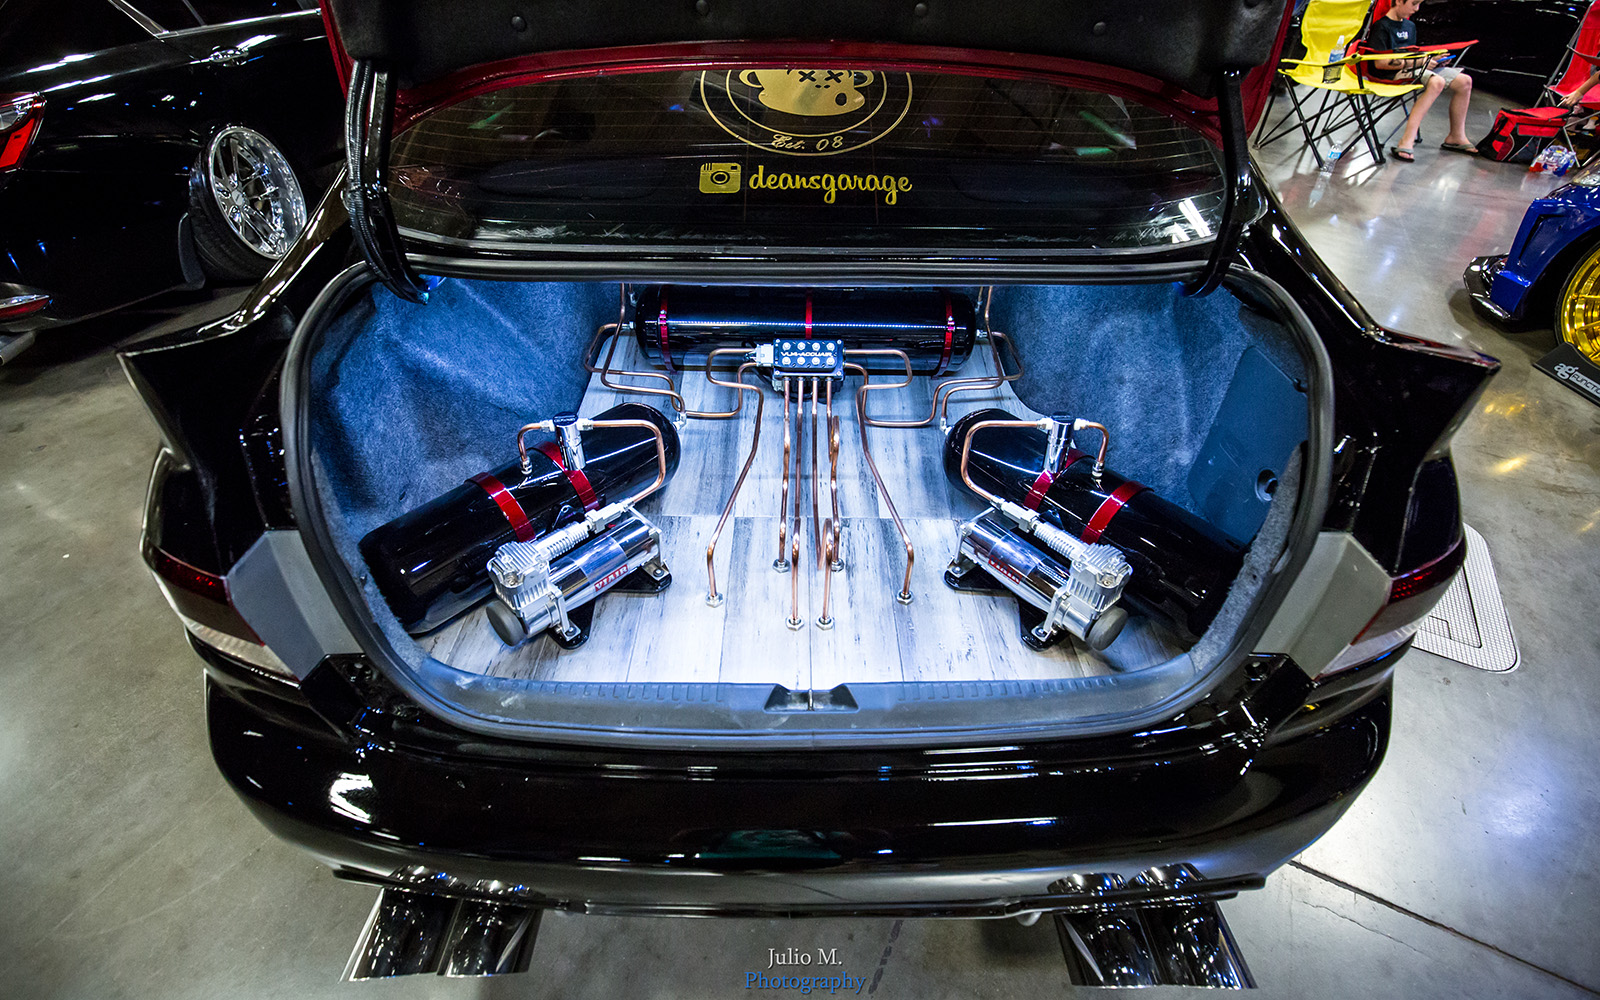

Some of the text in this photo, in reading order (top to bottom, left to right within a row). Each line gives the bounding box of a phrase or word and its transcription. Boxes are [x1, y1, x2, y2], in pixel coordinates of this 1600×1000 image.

[815, 135, 844, 151] 08
[748, 164, 913, 206] deansgarage
[594, 564, 628, 590] VIAIR
